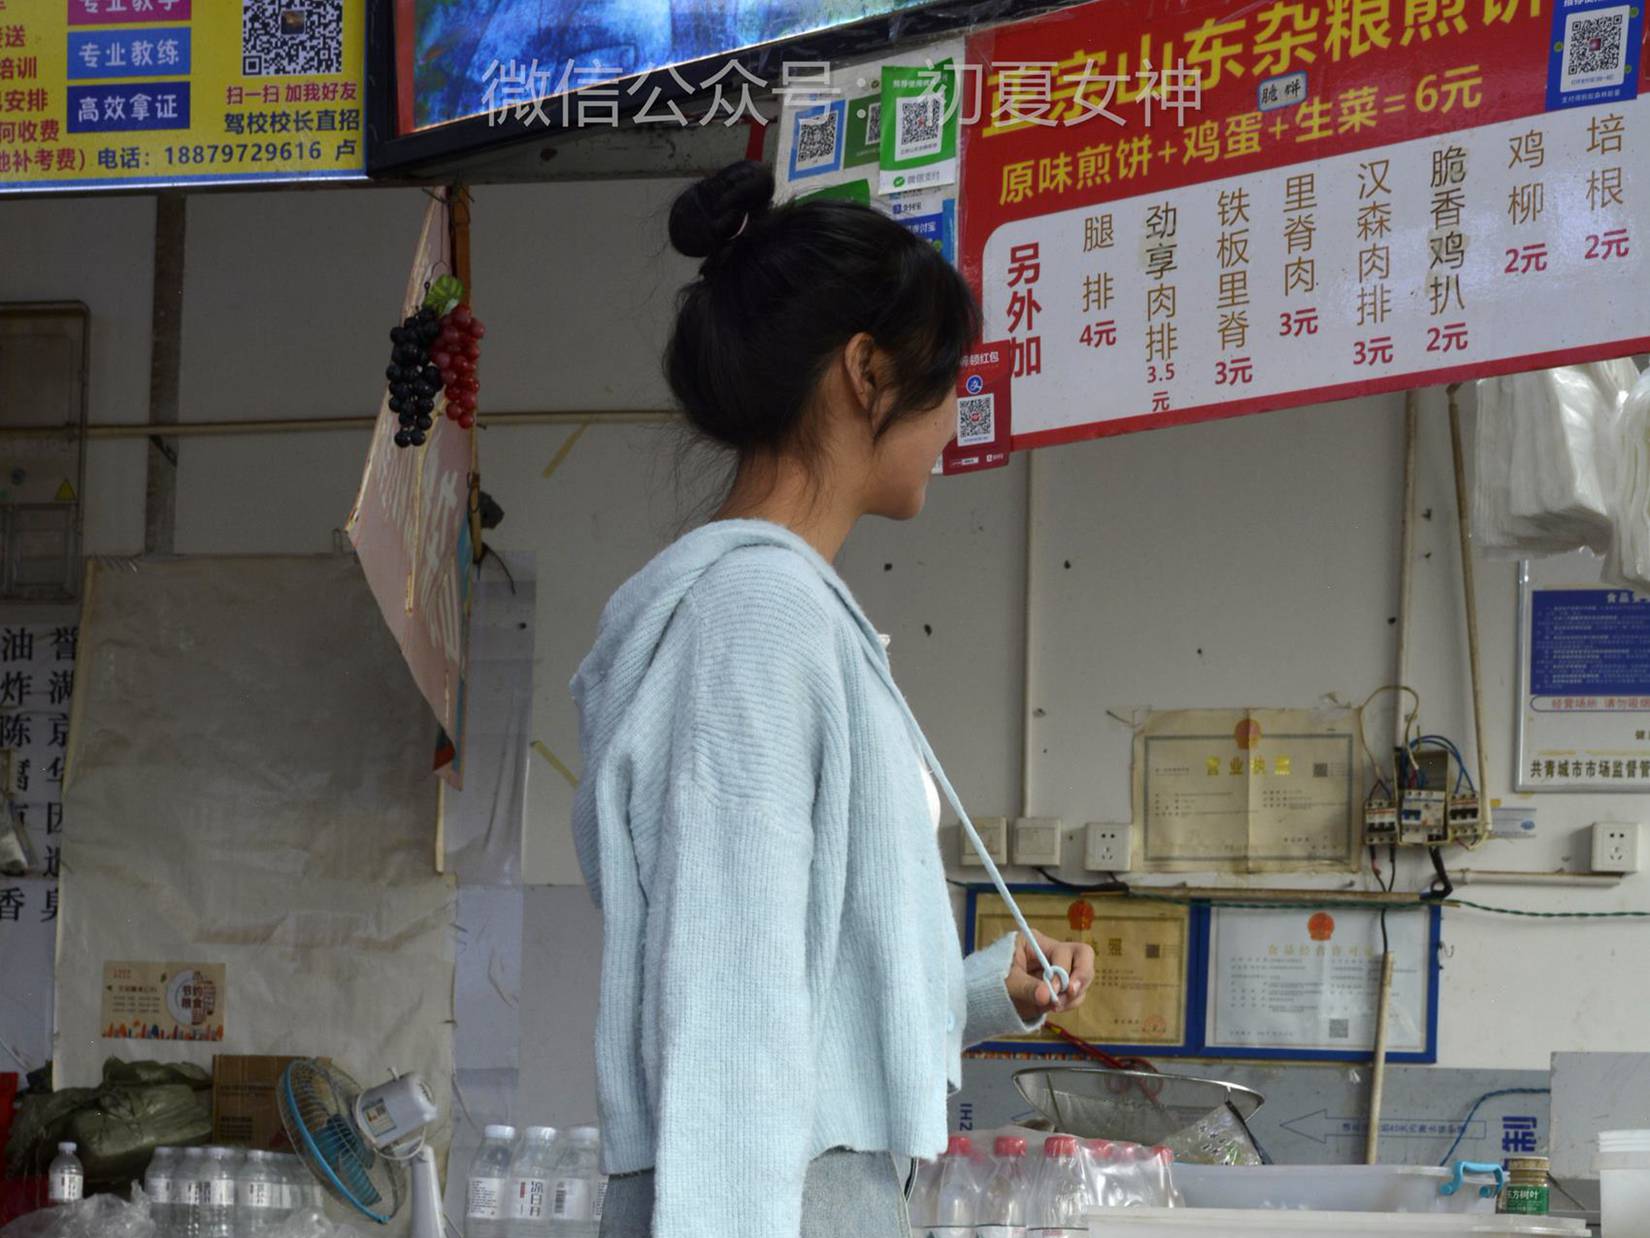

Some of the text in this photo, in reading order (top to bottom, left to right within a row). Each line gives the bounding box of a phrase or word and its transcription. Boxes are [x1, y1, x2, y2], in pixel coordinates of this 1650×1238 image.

[0, 24, 26, 48] 送
[78, 39, 180, 69] 专业教练
[0, 88, 49, 113] 安排
[77, 94, 179, 123] 高效拿证
[226, 81, 357, 105] 扫一扫 加我好友
[224, 109, 361, 134] 驾校校长直招
[165, 141, 322, 165] 18879729616
[335, 139, 357, 161] 卢
[1585, 114, 1625, 211] 培根
[1507, 129, 1545, 225] 鸡柳
[1283, 174, 1316, 295] 里脊肉
[1357, 159, 1392, 327] 汉森肉排
[1429, 145, 1467, 316] 脆香鸡扒
[1584, 227, 1630, 261] 2元
[1083, 216, 1114, 313] 腿排
[1216, 188, 1251, 351] 铁板里脊
[1505, 243, 1548, 274] 2元
[1145, 202, 1178, 362] 劲享肉排
[1007, 242, 1042, 379] 另外加
[1279, 307, 1319, 337] 3元
[1079, 320, 1117, 349] 4元
[1426, 321, 1469, 353] 2元
[1353, 336, 1394, 366] 3元
[1146, 362, 1176, 384] 3.5
[1215, 354, 1253, 386] 3元
[1152, 391, 1170, 412] 元
